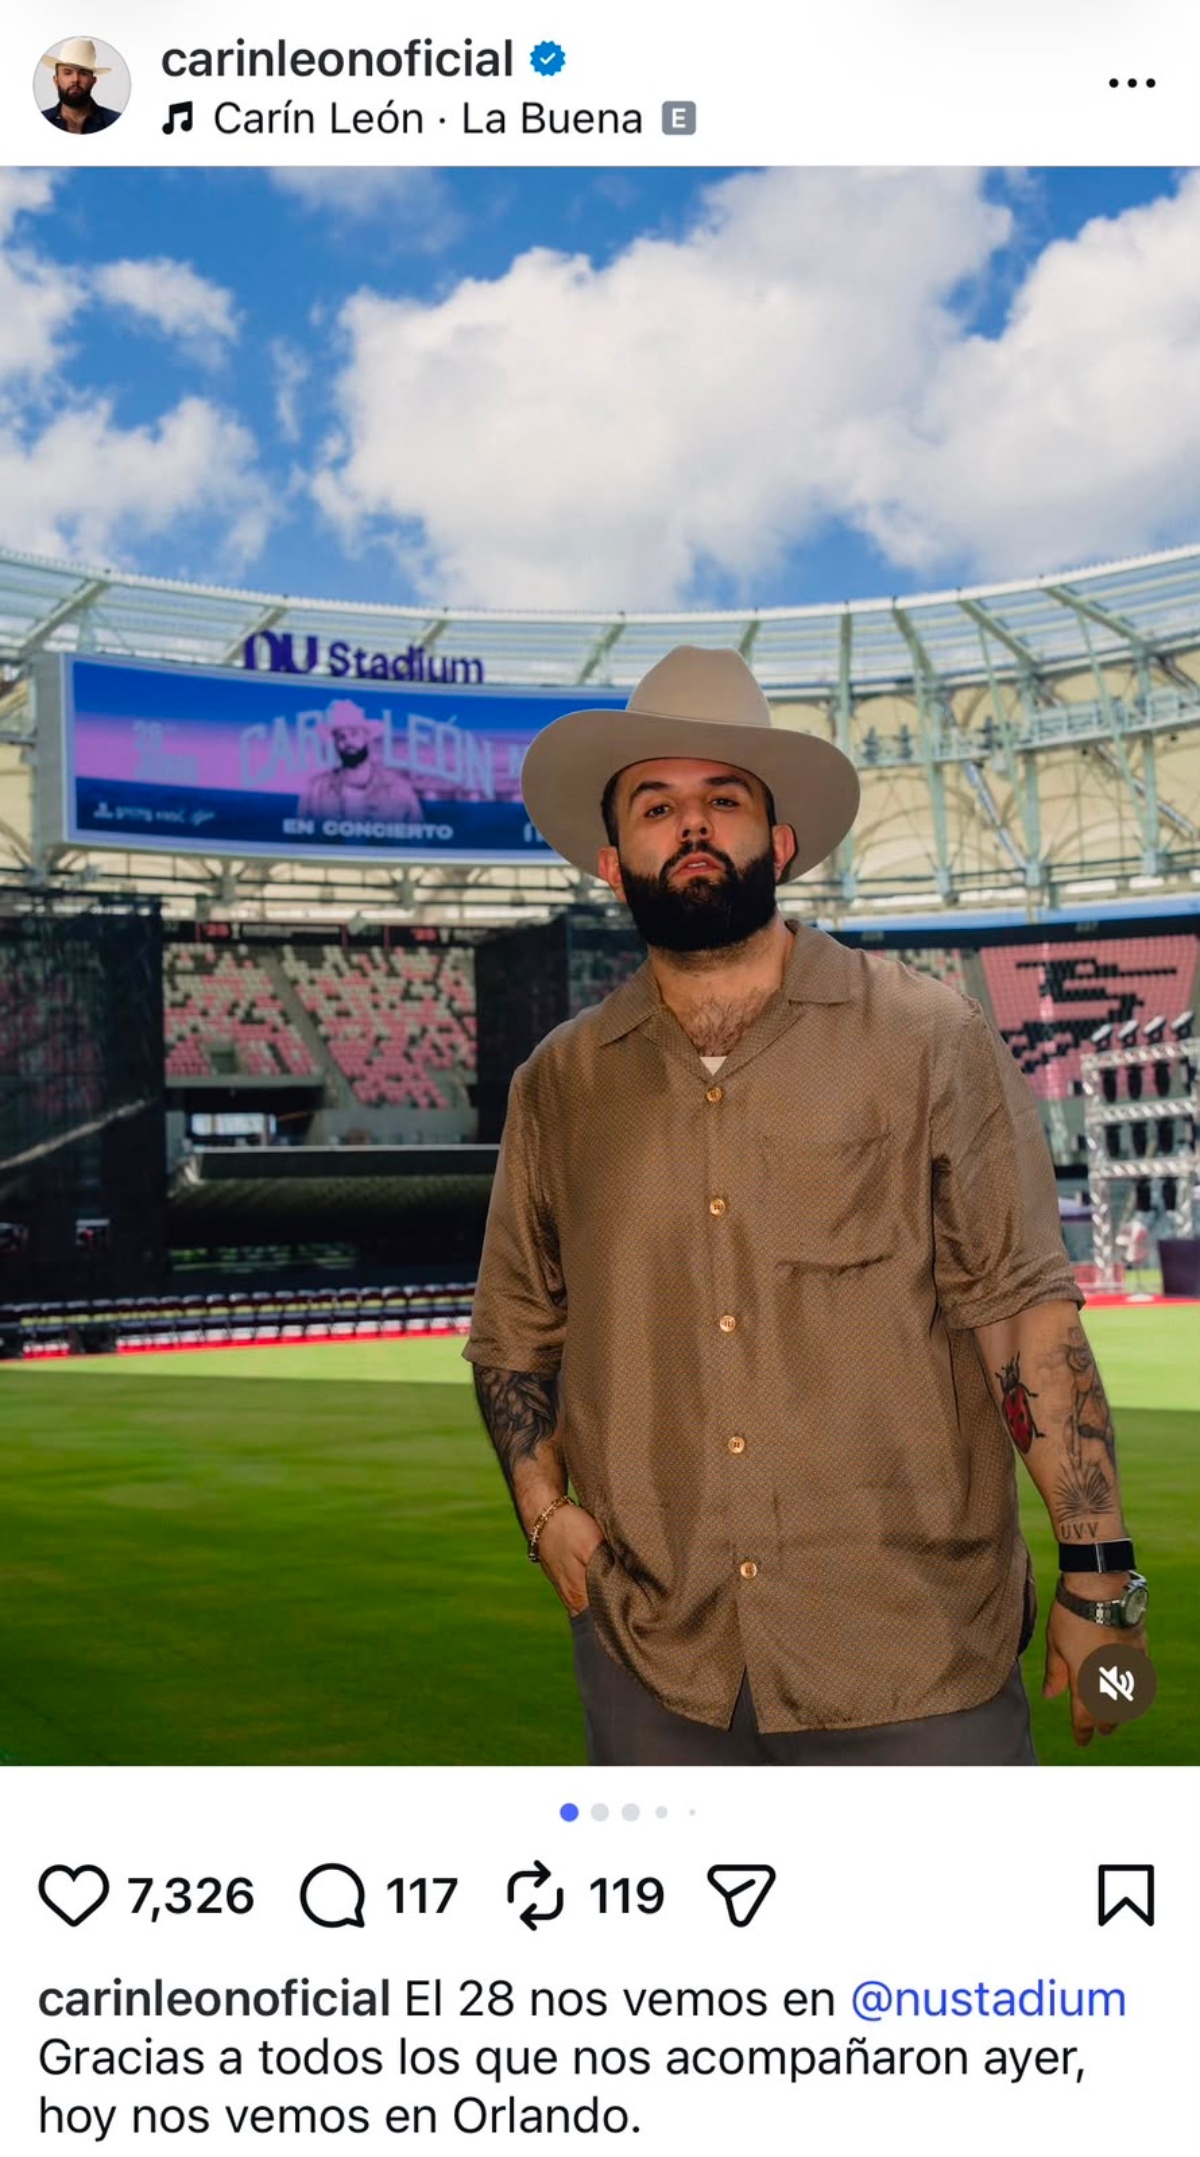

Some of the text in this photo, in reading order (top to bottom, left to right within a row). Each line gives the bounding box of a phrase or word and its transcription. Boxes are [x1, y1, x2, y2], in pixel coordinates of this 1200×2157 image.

[329, 642, 484, 684] Stadium
[382, 709, 496, 799] LEÓN
[282, 818, 453, 840] EN CONCIERTO
[1060, 1522, 1099, 1540] UVV
